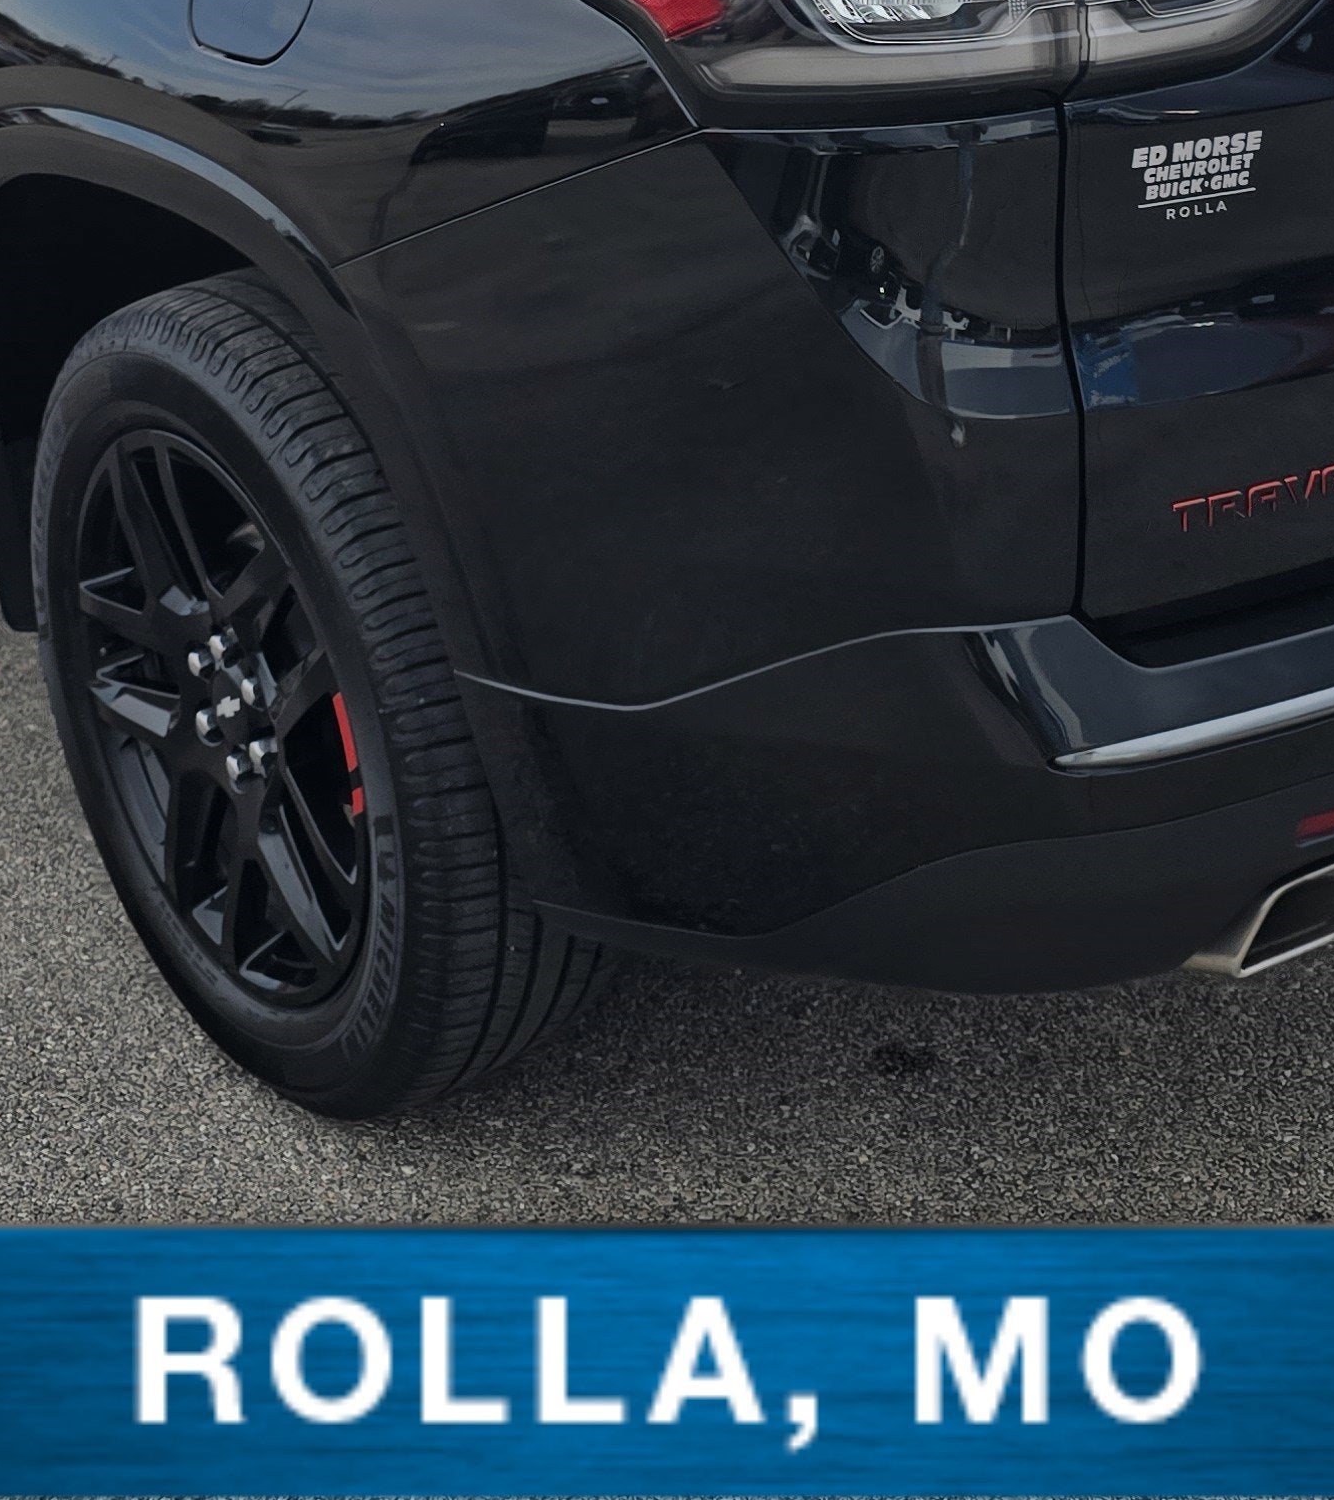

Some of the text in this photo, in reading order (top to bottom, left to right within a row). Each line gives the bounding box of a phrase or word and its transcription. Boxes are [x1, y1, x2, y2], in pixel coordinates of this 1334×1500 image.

[1131, 130, 1263, 169] ED MORSE
[1143, 153, 1254, 184] CHEVROLET
[1166, 200, 1228, 220] ROLLA
